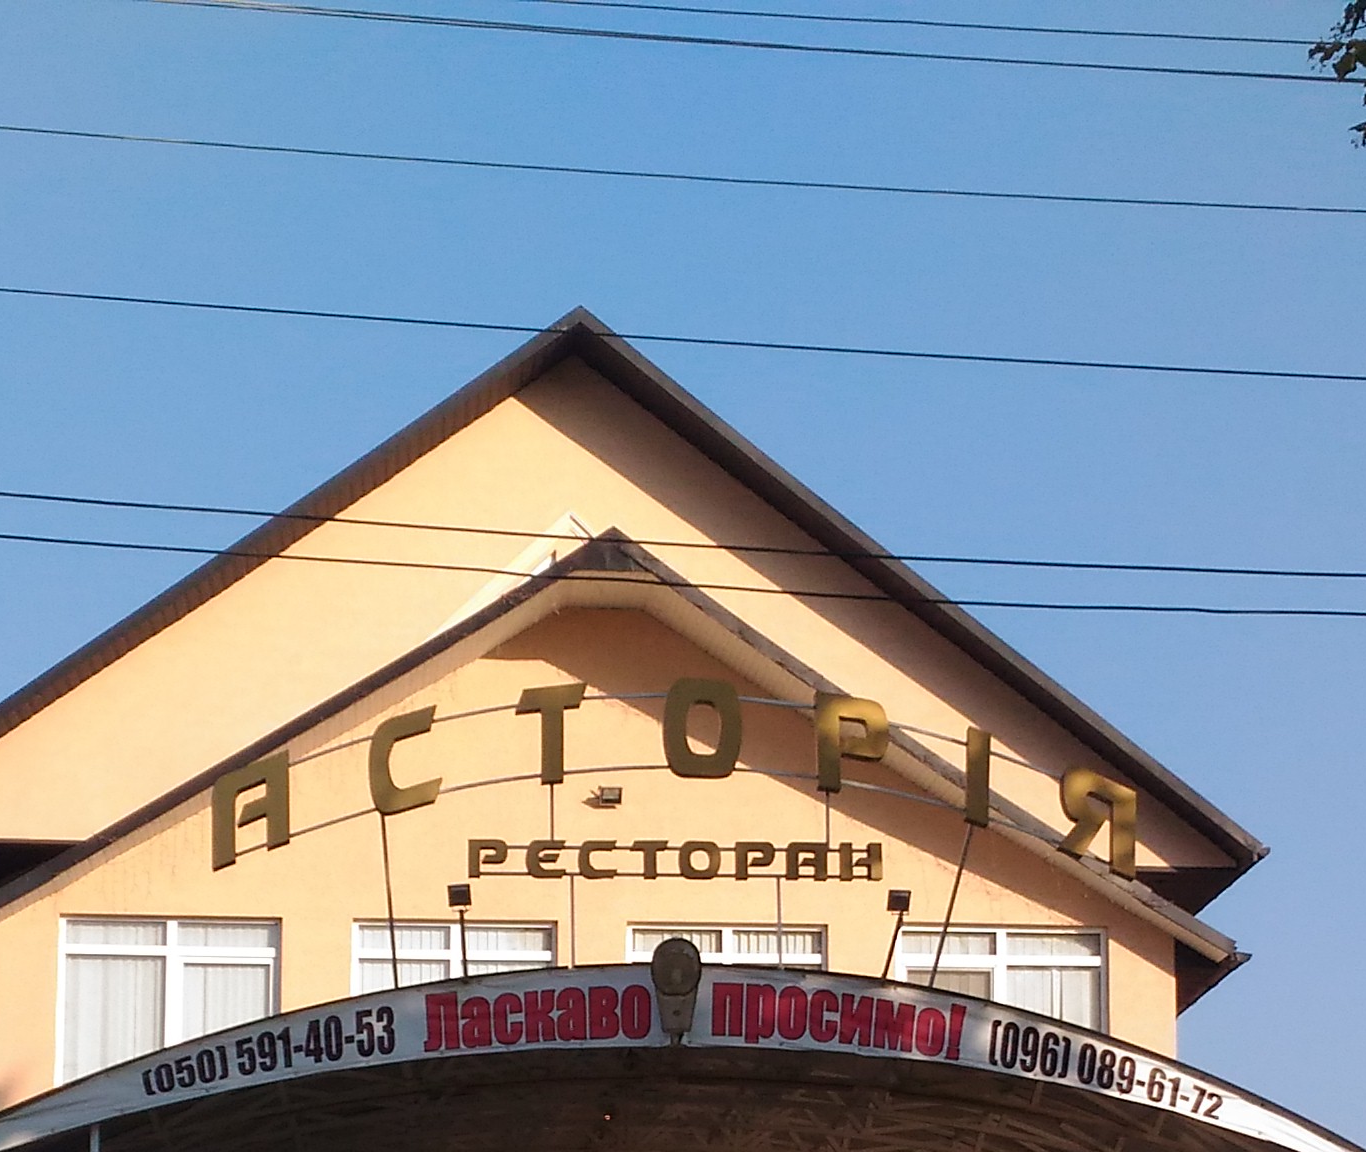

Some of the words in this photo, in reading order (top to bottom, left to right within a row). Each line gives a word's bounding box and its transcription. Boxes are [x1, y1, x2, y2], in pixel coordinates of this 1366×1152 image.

[211, 678, 1136, 879] АСТОРІЯ
[468, 839, 882, 880] РЕСТОРАН
[142, 1047, 229, 1096] (050)
[236, 1006, 395, 1076] 591-40-53
[424, 985, 651, 1053] Ласкаво
[711, 982, 967, 1060] просимо!
[988, 1019, 1072, 1078] (096)
[1077, 1042, 1225, 1120] 089-61-72
